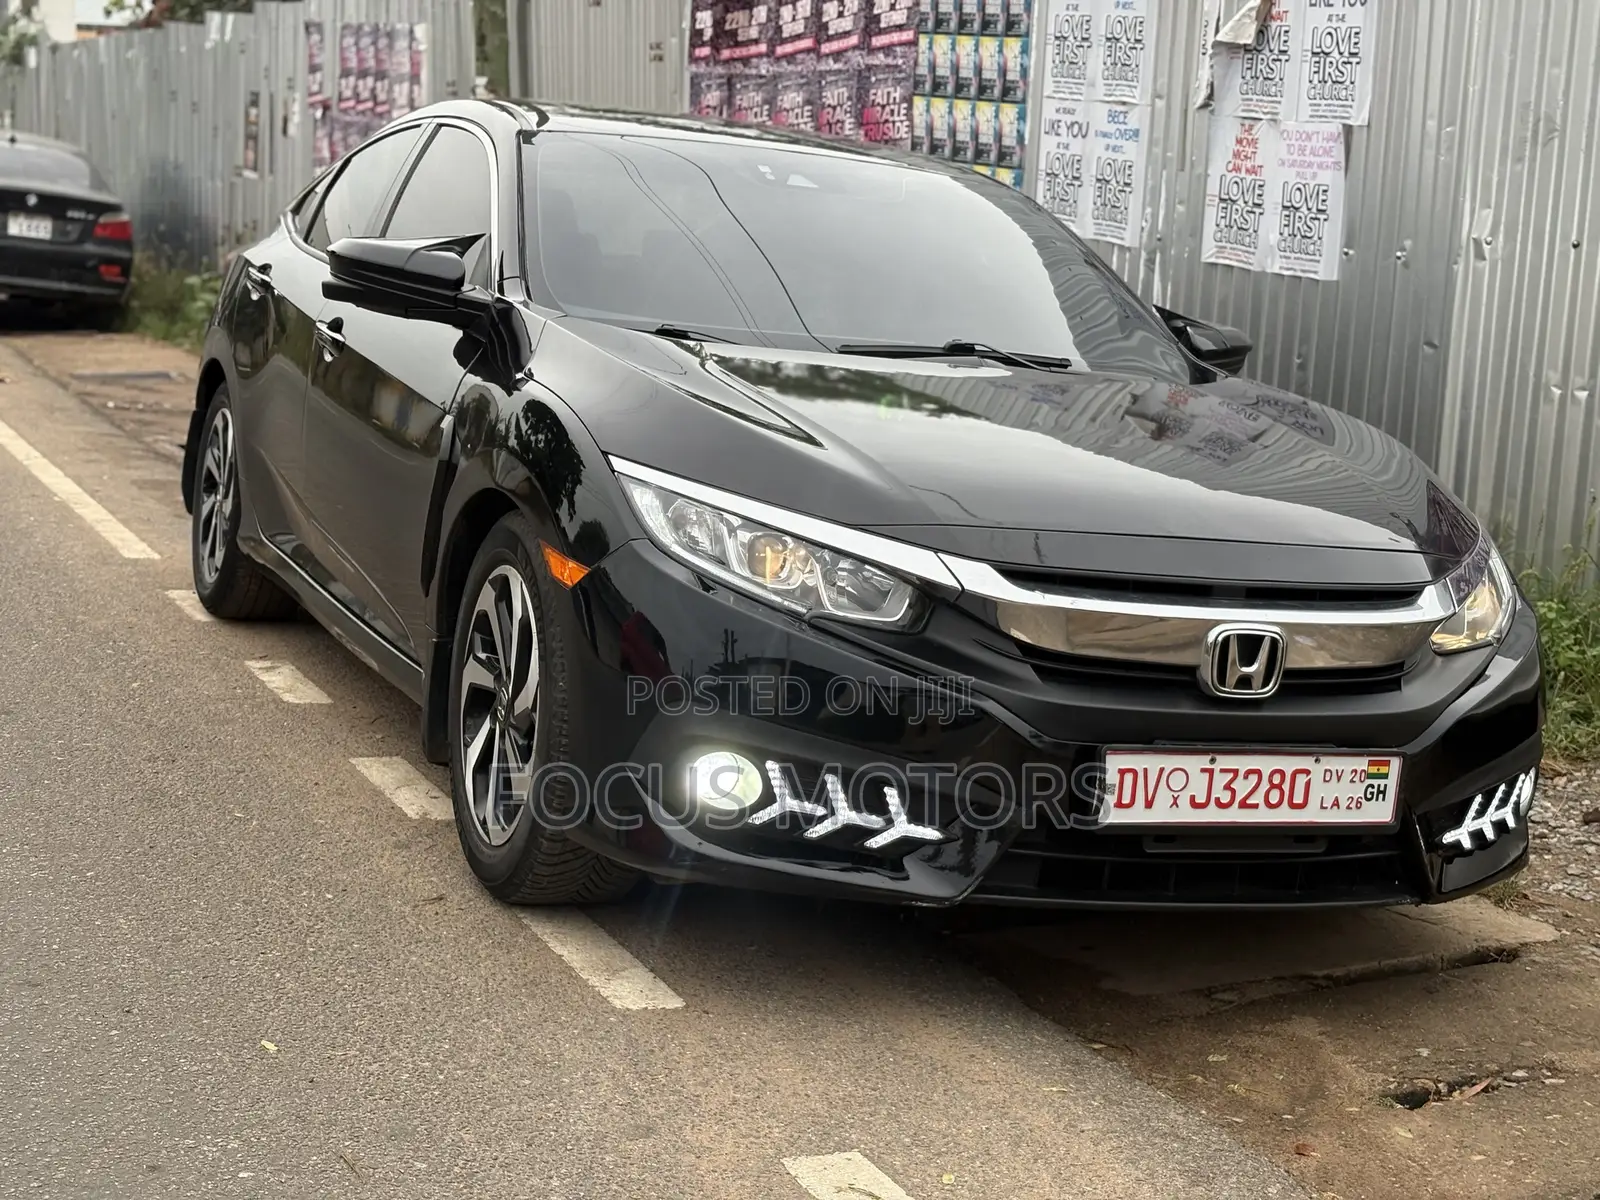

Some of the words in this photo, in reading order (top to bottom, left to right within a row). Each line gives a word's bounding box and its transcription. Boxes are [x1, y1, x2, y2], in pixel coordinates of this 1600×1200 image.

[1054, 14, 1092, 40] LOVE
[1104, 14, 1145, 42] LOVE
[1052, 39, 1093, 66] FIRST
[1311, 26, 1362, 56] LOVE
[1102, 41, 1145, 68] FIRST
[1102, 66, 1140, 83] CHURCH
[1241, 53, 1291, 81] FIRST
[1308, 55, 1361, 84] FIRST
[1239, 80, 1285, 98] CHURCH
[1307, 83, 1356, 102] CHURCH
[1044, 117, 1062, 136] LIKE
[1065, 121, 1090, 139] YOU
[1107, 109, 1129, 125] BECE
[1240, 123, 1254, 136] THE
[1295, 130, 1319, 143] DON'T
[1235, 136, 1259, 149] MOVIE
[1287, 144, 1297, 156] TO
[1299, 145, 1308, 157] BE
[1309, 146, 1335, 158] ALONE
[1045, 151, 1082, 180] LOVE
[1232, 149, 1257, 162] NIGHT
[1095, 156, 1134, 187] LOVE
[1226, 161, 1242, 175] CAN
[1245, 165, 1264, 177] WAIT
[1043, 177, 1083, 204] FIRST
[1093, 182, 1133, 210] FIRST
[1219, 174, 1265, 207] LOVE
[1282, 181, 1329, 213] LOVE
[1215, 202, 1264, 233] FIRST
[1279, 210, 1329, 240] FIRST
[1213, 227, 1259, 249] CHURCH
[1277, 237, 1325, 257] CHURCH
[1322, 768, 1344, 783] DV
[1349, 768, 1367, 783] 20
[1189, 767, 1313, 809] J3280
[1363, 783, 1388, 802] GH
[1320, 796, 1340, 810] LA
[1345, 796, 1363, 810] 26
